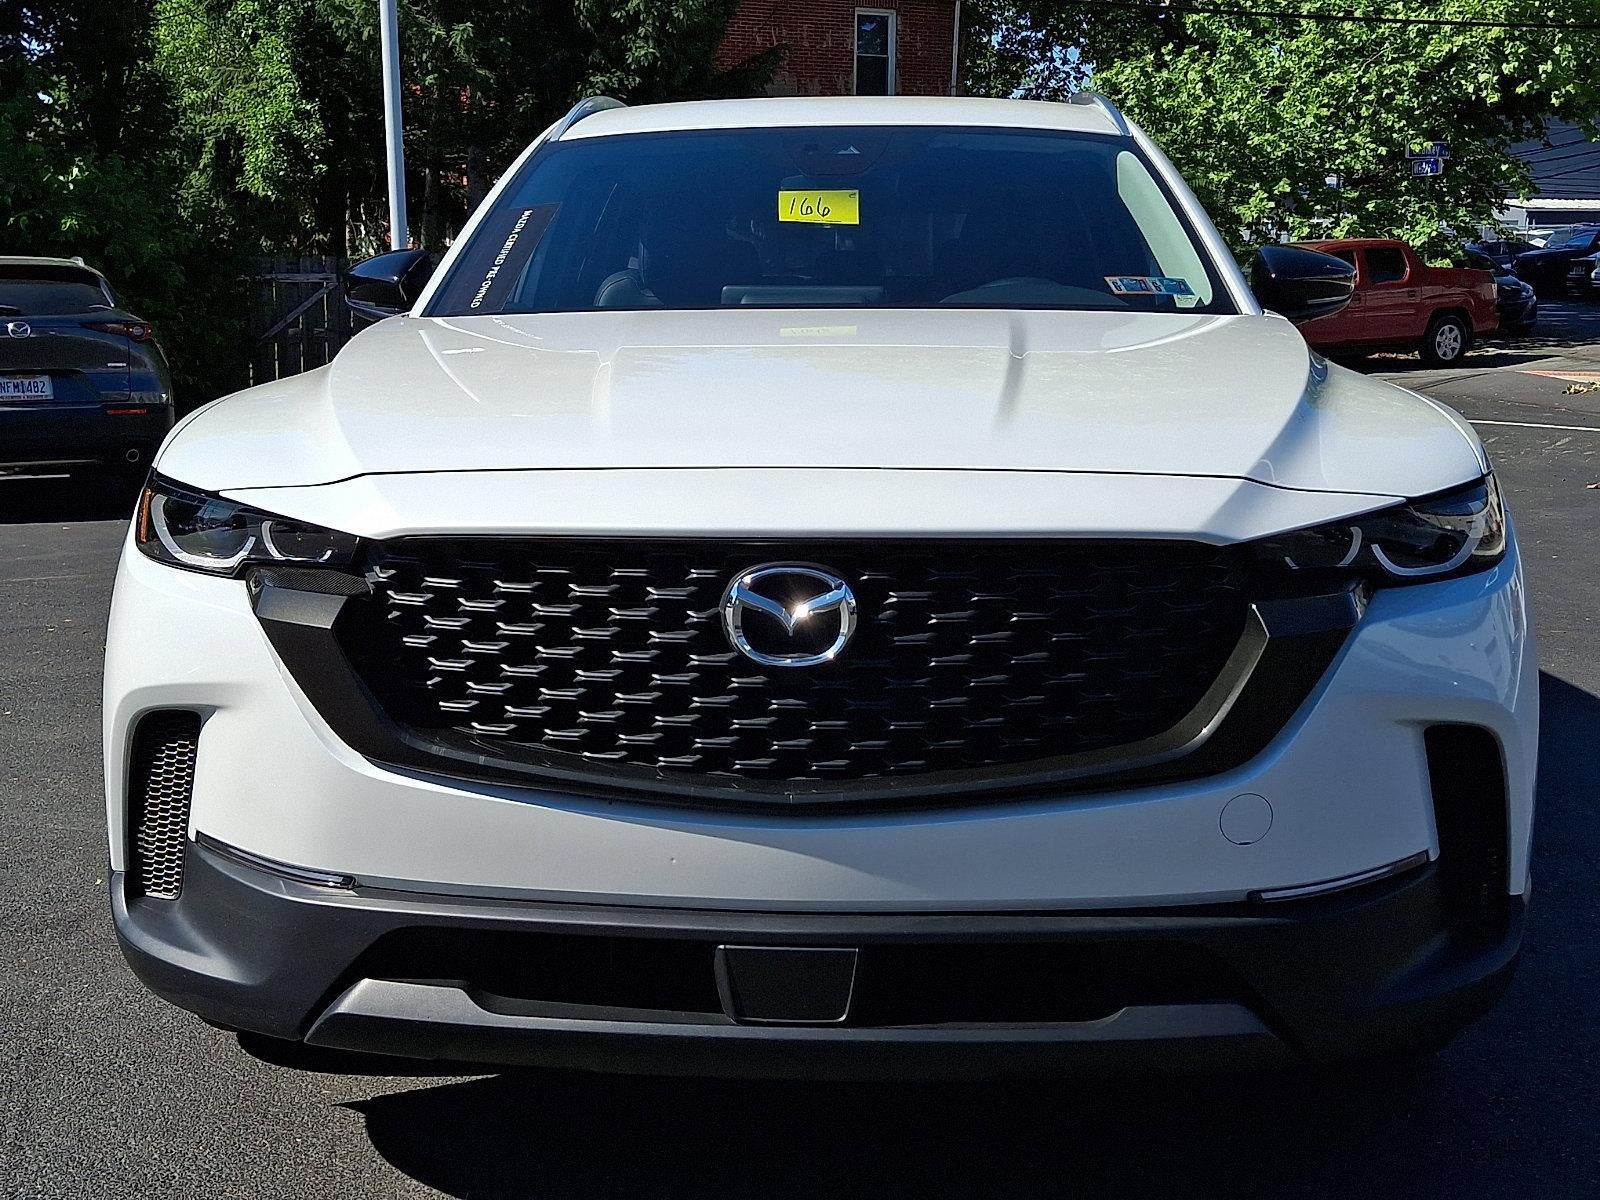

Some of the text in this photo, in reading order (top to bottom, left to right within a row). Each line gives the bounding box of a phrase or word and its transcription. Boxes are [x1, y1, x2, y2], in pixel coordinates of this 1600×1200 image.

[790, 197, 831, 217] 166
[470, 209, 533, 308] MAZDA CERTIFIED PRE-OWNED
